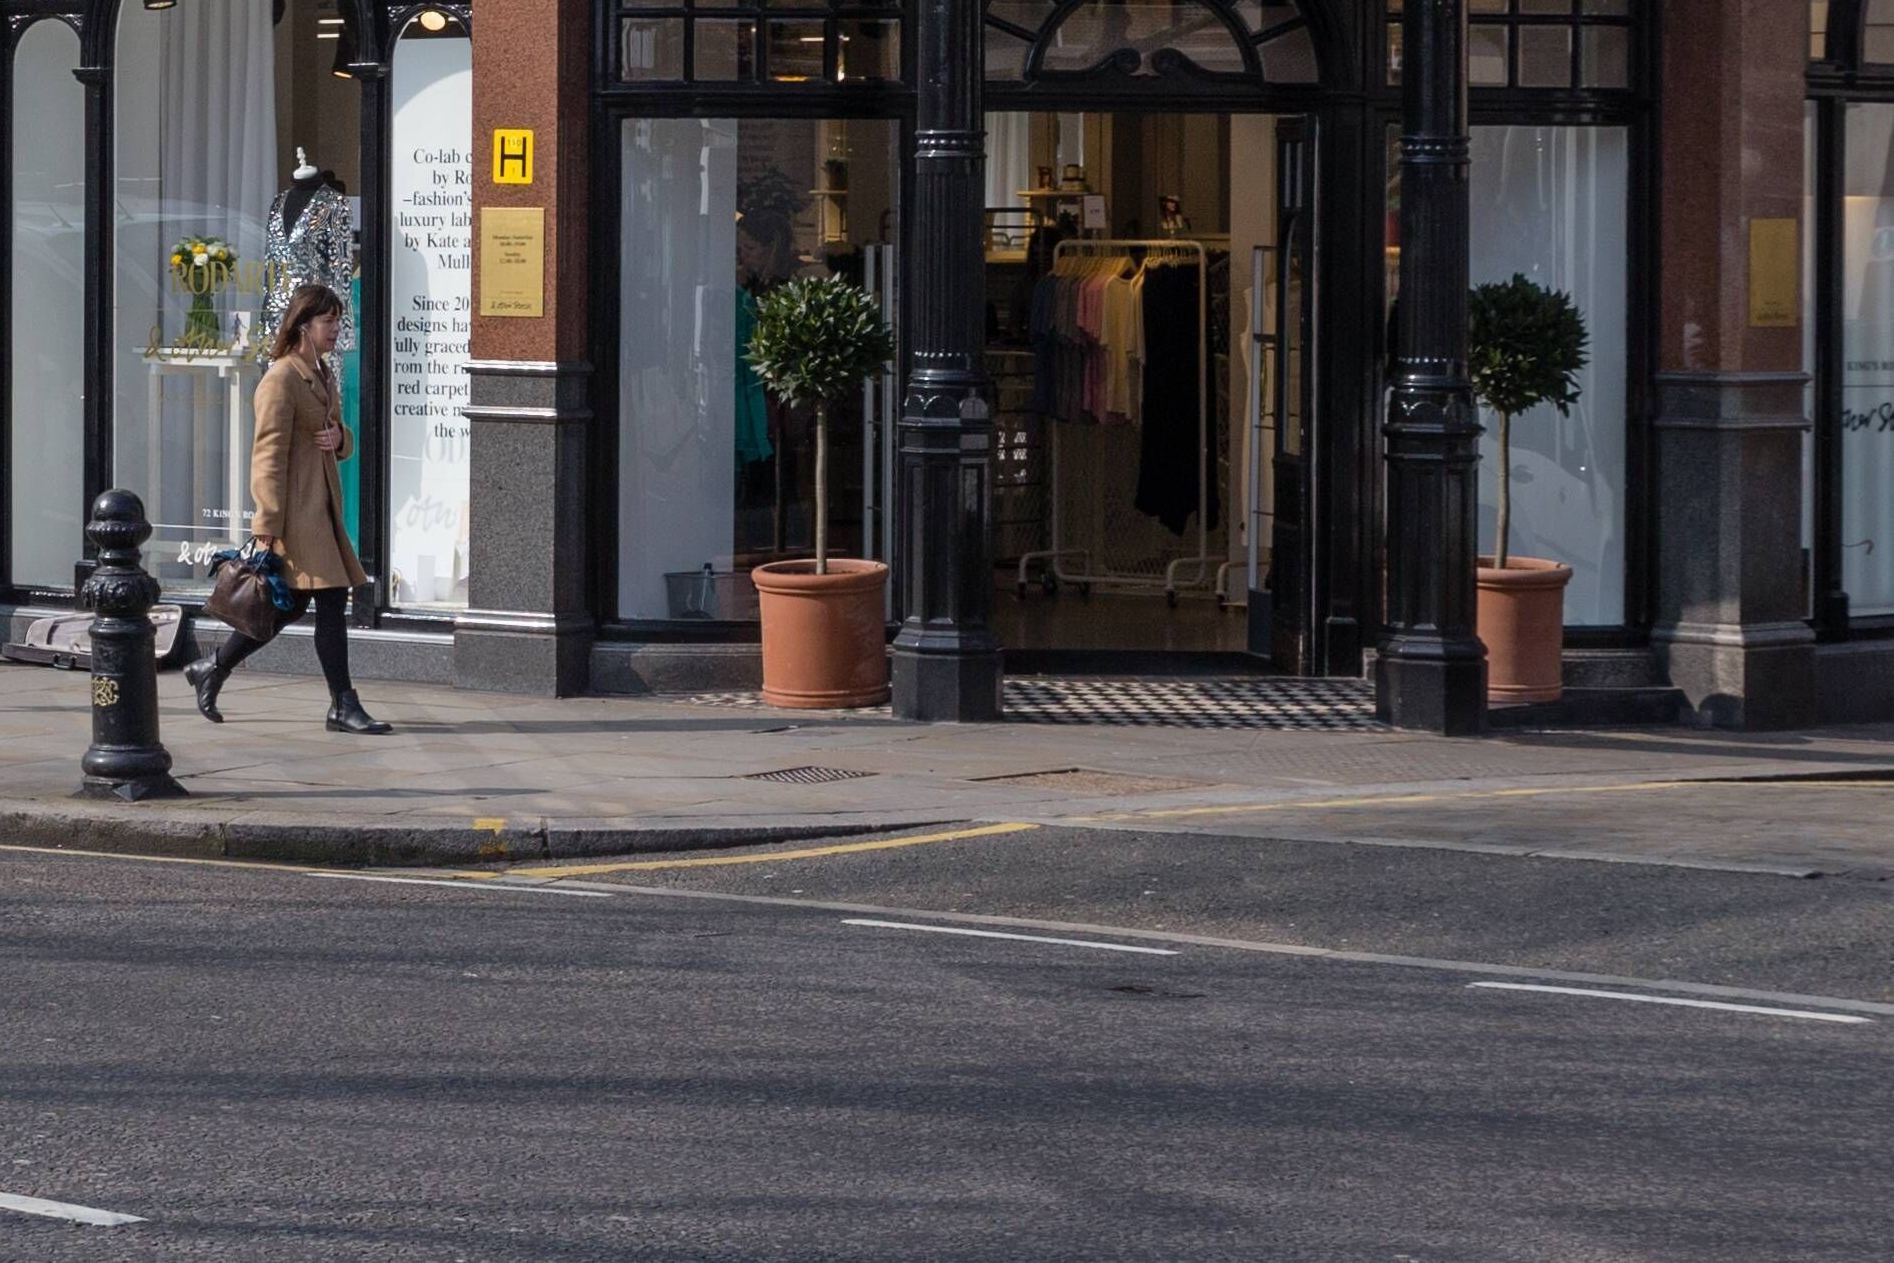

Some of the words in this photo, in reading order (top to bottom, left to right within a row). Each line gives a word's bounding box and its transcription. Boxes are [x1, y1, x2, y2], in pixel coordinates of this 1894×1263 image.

[413, 147, 461, 164] Co-lab
[500, 136, 527, 178] H
[432, 169, 448, 189] by
[400, 211, 446, 231] luxury
[404, 232, 421, 252] by
[427, 232, 459, 248] Kate
[412, 295, 449, 311] Since
[397, 316, 448, 336] designs
[143, 324, 167, 363] &
[425, 339, 470, 357] graced
[427, 360, 449, 375] the
[397, 379, 421, 395] red
[425, 384, 469, 400] carpet
[394, 401, 448, 417] creative
[434, 422, 456, 438] the
[177, 540, 194, 565] &
